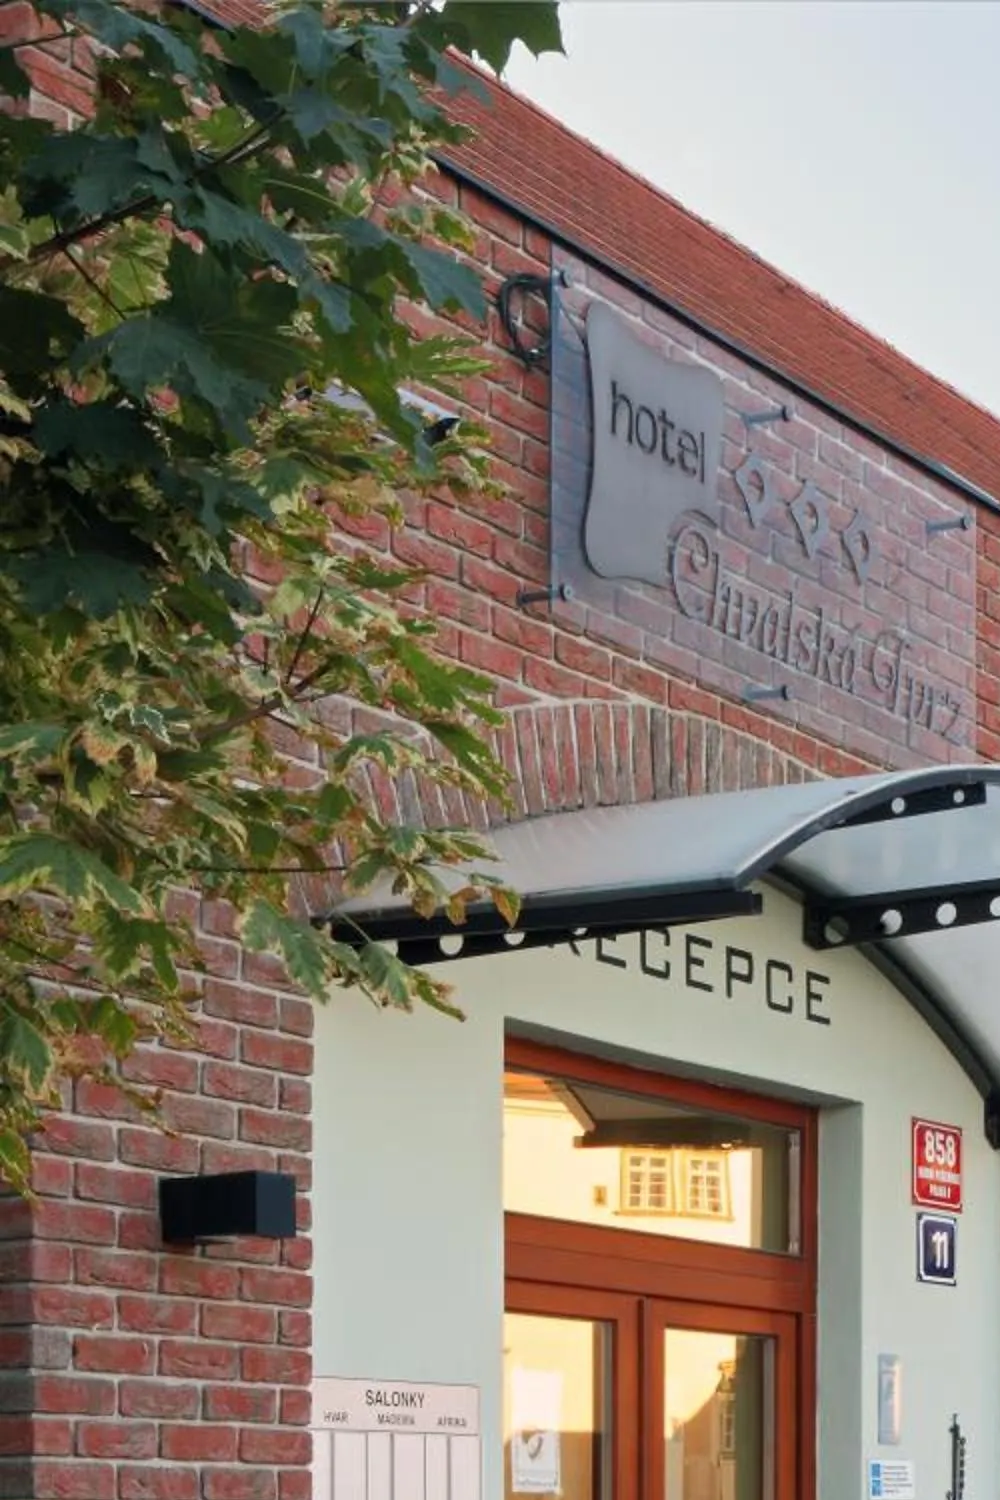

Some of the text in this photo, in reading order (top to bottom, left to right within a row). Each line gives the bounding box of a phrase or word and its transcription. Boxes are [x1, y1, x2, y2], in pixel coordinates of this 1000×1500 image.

[610, 380, 705, 484] hotel
[924, 1129, 957, 1168] 858
[931, 1231, 949, 1269] 11
[365, 1389, 425, 1409] SALONKY
